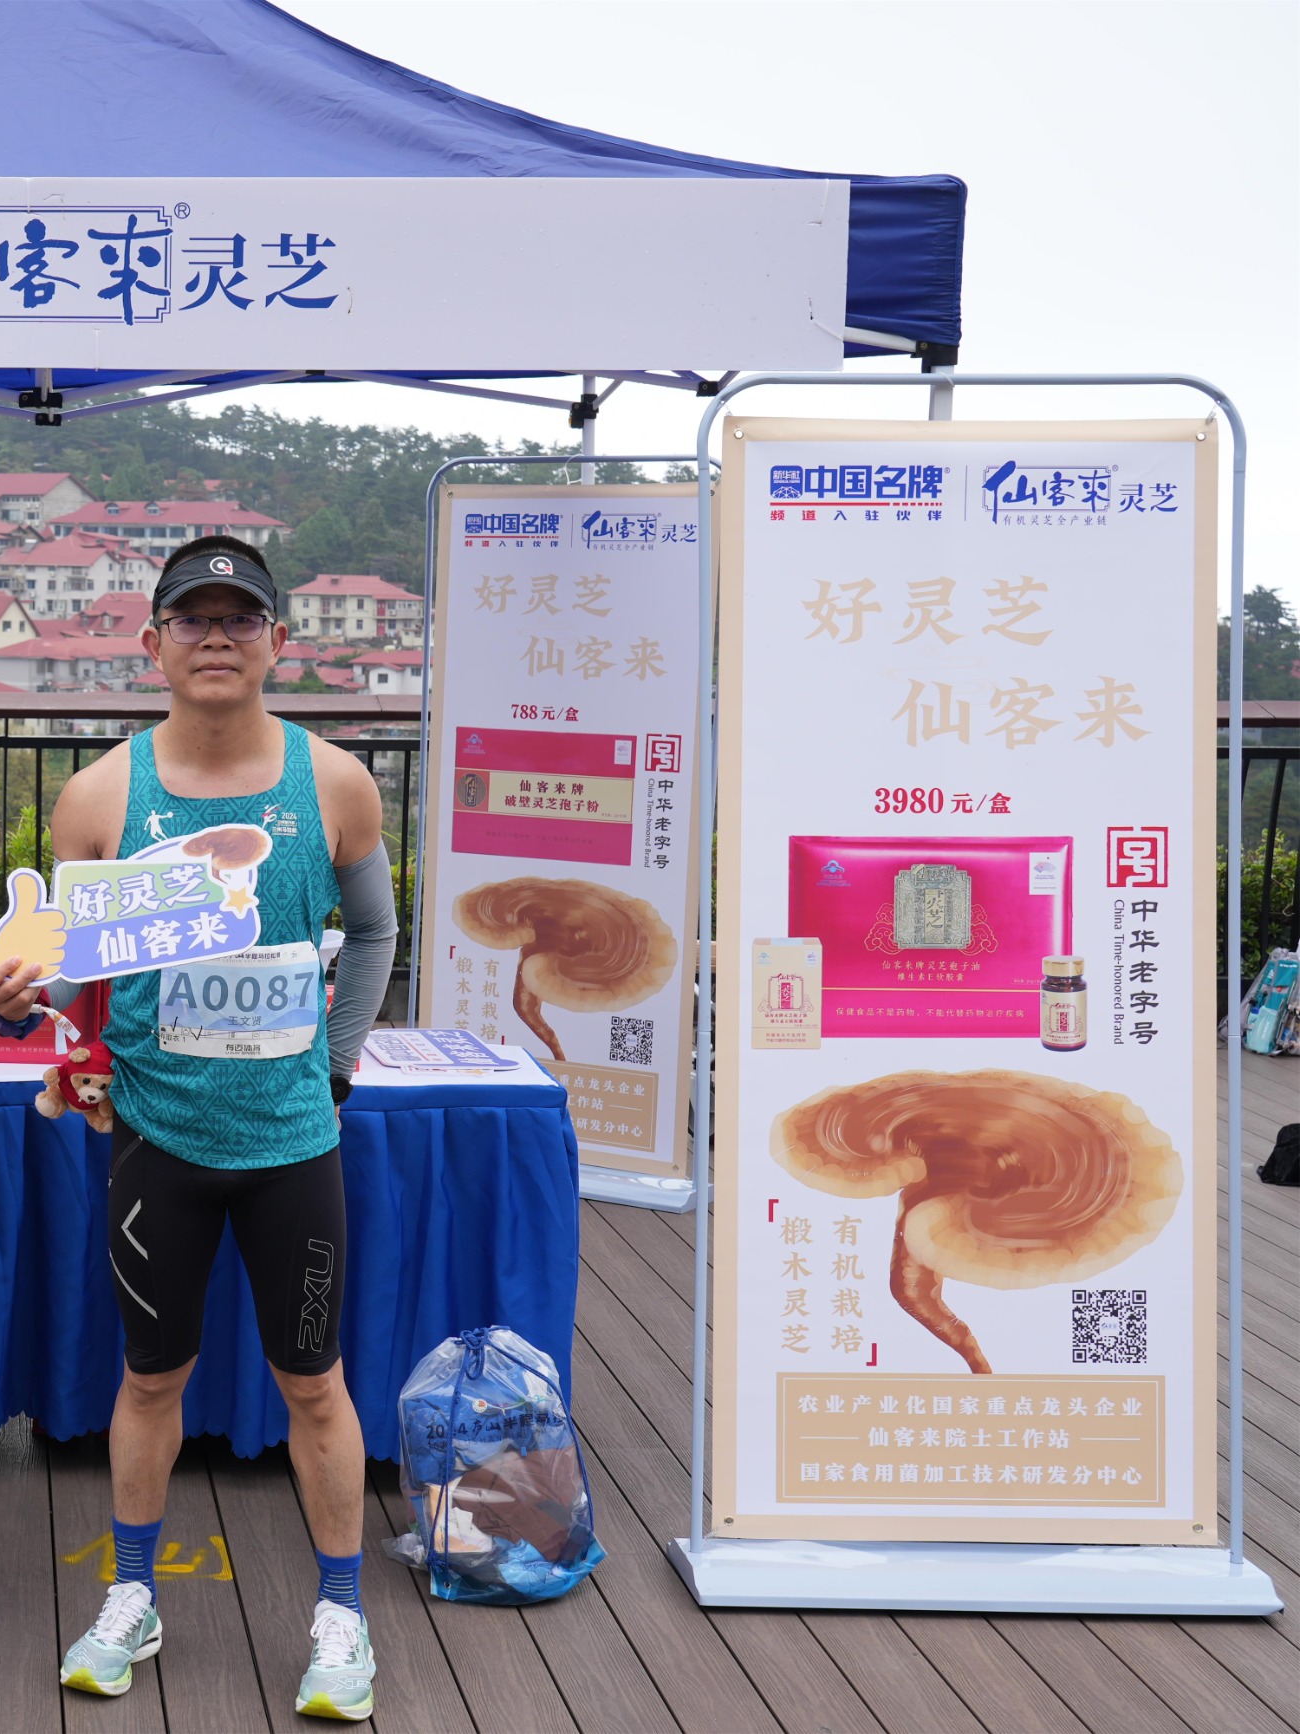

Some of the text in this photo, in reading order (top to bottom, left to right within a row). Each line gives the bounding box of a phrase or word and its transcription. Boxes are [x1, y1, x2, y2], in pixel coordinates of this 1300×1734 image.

[804, 465, 943, 499] 中国名牌
[483, 513, 560, 534] 中国名牌
[770, 509, 942, 522] 频道入驻伙伴
[1002, 514, 1108, 527] 有机灵芝全产业链
[473, 572, 615, 618] 好灵芝
[801, 575, 1055, 647] 好灵芝
[520, 635, 669, 681] 仙客来
[890, 675, 1154, 751] 仙客来
[504, 795, 600, 813] 破壁灵芝孢子粉
[519, 779, 585, 796] 仙客来牌
[647, 778, 655, 798] China
[652, 779, 674, 869] 中华老字号
[644, 848, 652, 868] Brand
[67, 864, 210, 926] 好灵芝
[96, 911, 230, 968] 仙客来
[897, 972, 965, 982] 维生素E软胶囊
[1113, 899, 1125, 1045] China Time-honored Brand
[1129, 899, 1160, 1045] 中华老字号
[165, 970, 315, 1012] A0087
[480, 958, 501, 1041] 有机栽培
[228, 1016, 262, 1026] 王文贤
[558, 1073, 646, 1097] 重点龙头企业
[571, 1117, 643, 1137] 研发分中心
[297, 1238, 335, 1353] 2XU
[779, 1215, 813, 1355] 椴木灵芝
[830, 1214, 866, 1355] 有机栽培
[797, 1394, 1143, 1417] 农业产业化国家重点龙头企业
[867, 1426, 1071, 1449] 仙客来院士工作站
[799, 1462, 1143, 1486] 国家食用菌加工技术研发分中心
